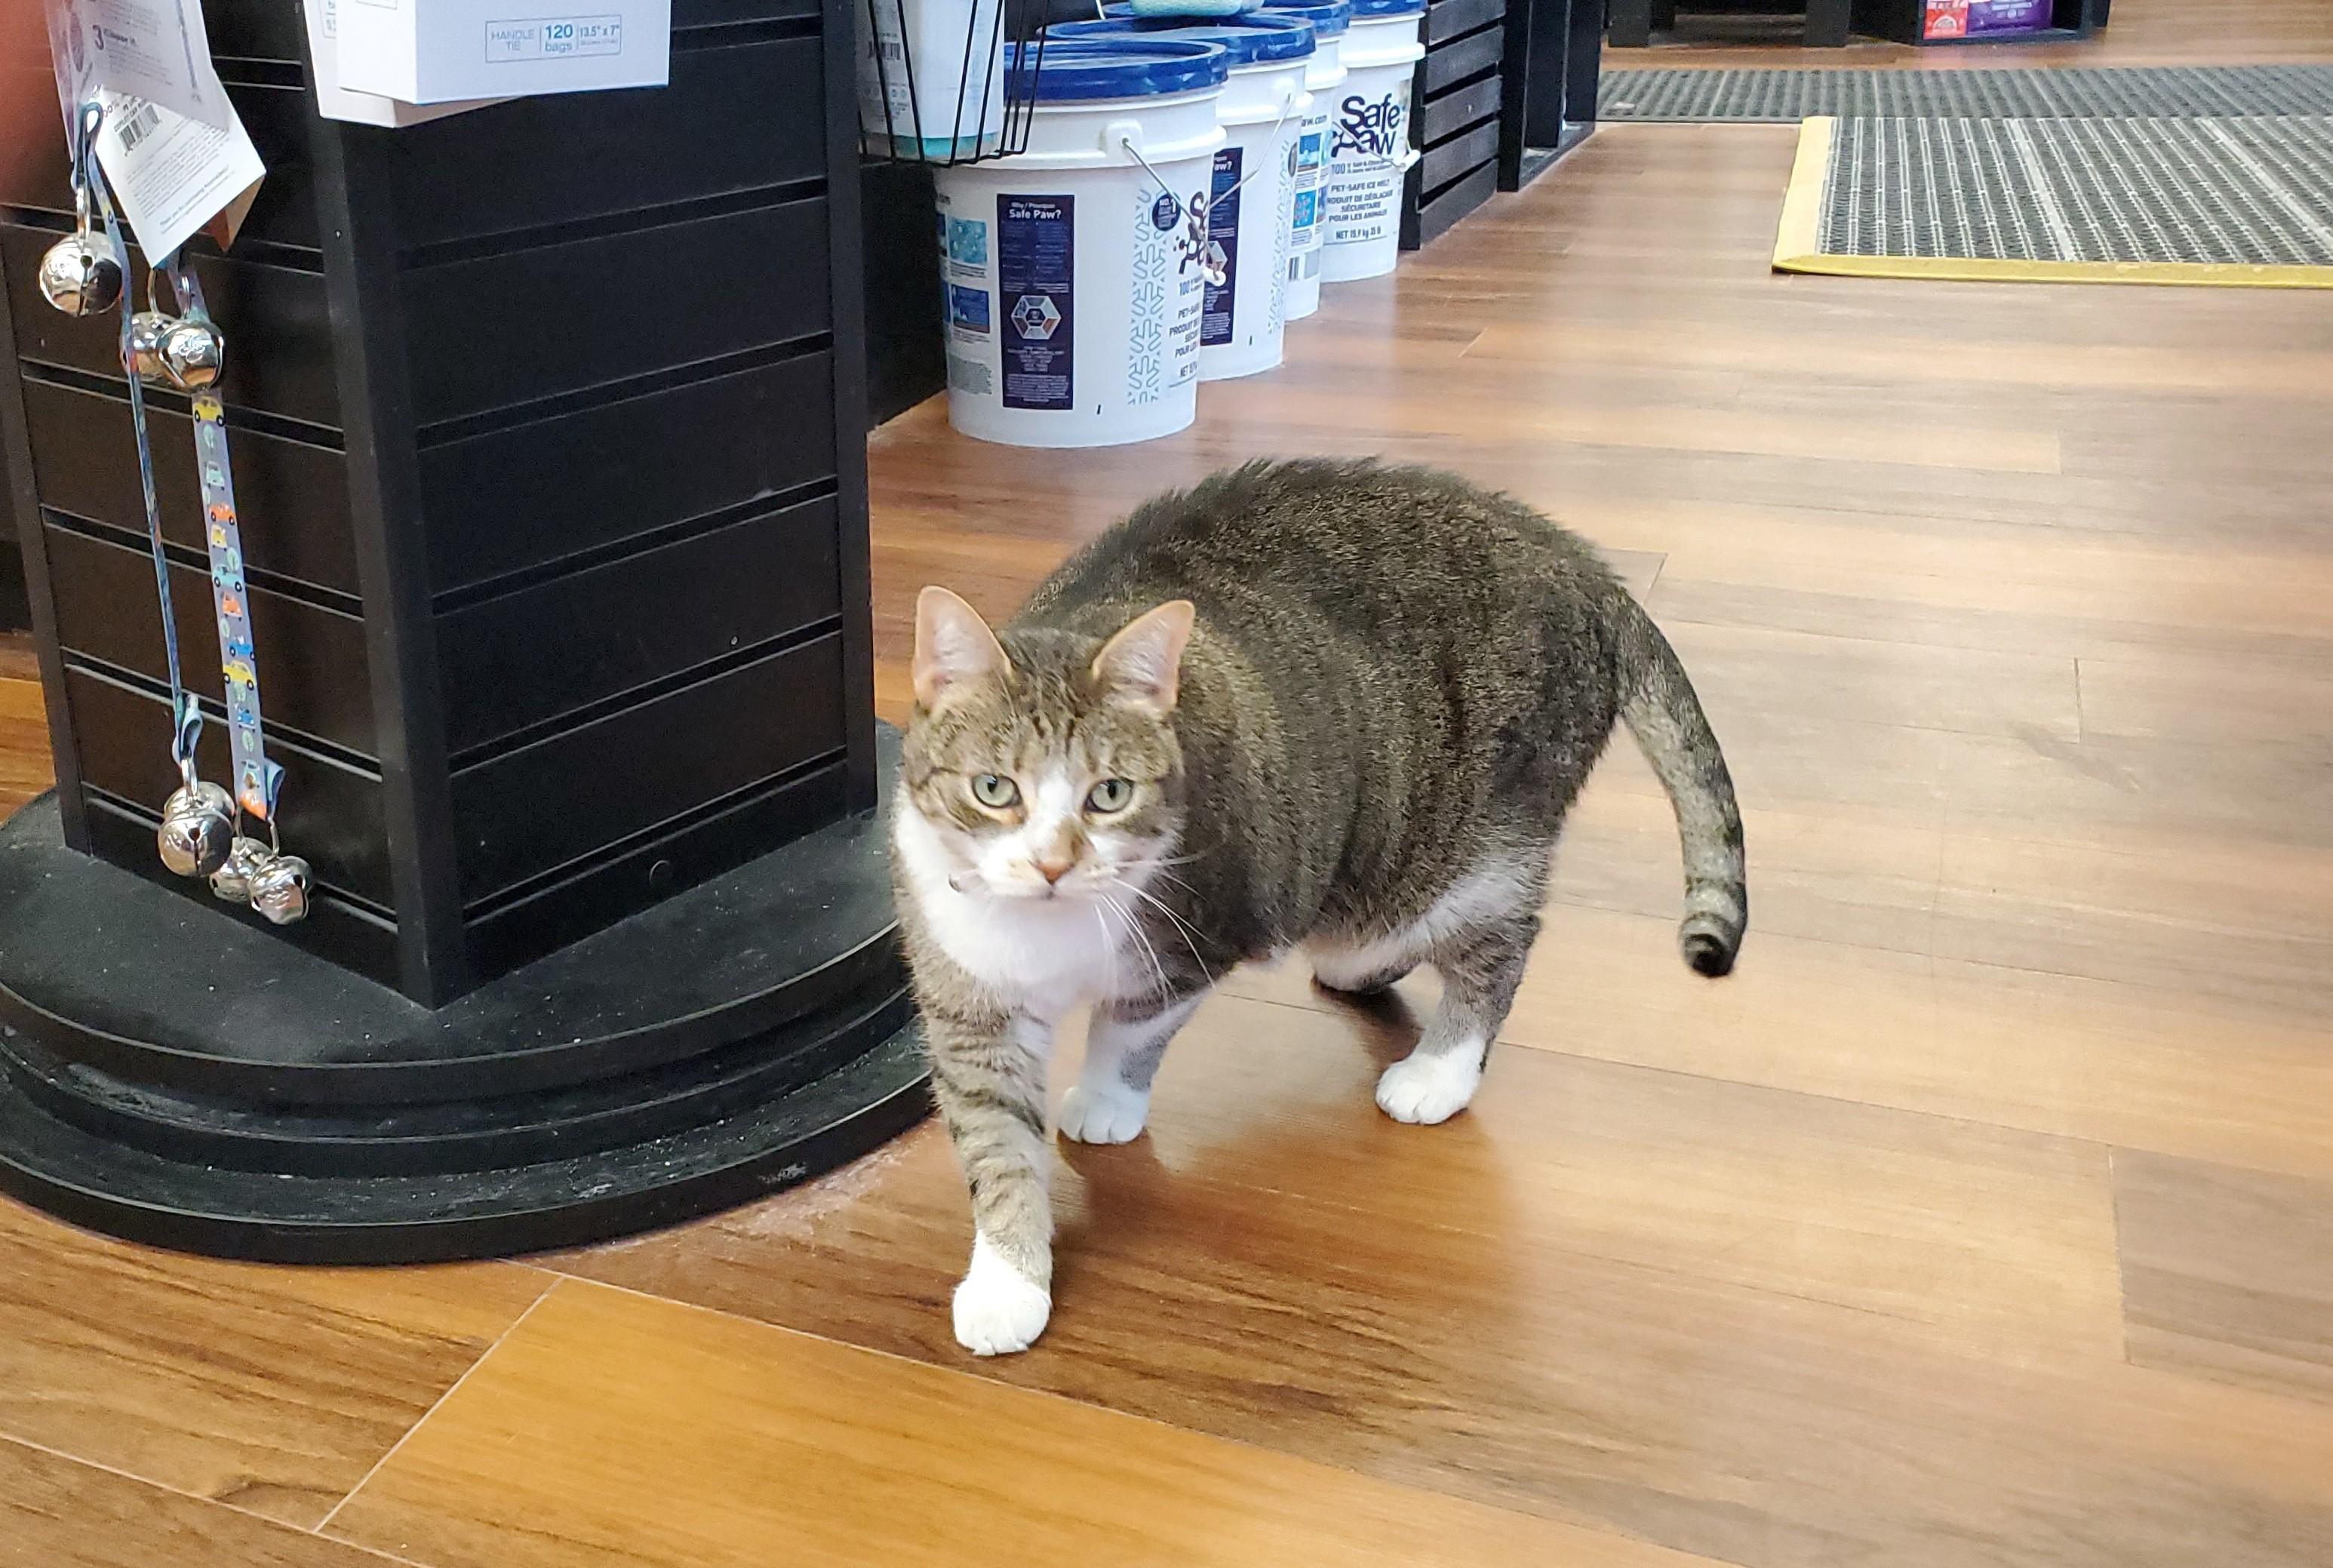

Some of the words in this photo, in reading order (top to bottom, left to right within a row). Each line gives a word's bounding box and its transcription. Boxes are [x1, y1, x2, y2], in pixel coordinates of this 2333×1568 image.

[491, 29, 535, 40] HANDLE
[545, 24, 573, 39] 120
[506, 41, 521, 51] TIE
[545, 42, 573, 54] bags
[1342, 93, 1400, 134] Safe
[1330, 118, 1397, 158] Paw
[1214, 160, 1233, 171] aw?
[1330, 162, 1346, 175] 100
[1330, 182, 1366, 192] PET-SAFE
[1366, 180, 1376, 189] ICE
[1326, 195, 1353, 204] RODUIT
[1009, 208, 1031, 219] Safe
[1033, 208, 1062, 220] Paw?
[1329, 214, 1348, 223] POUR
[1350, 213, 1363, 221] LES
[1336, 229, 1348, 240] NET
